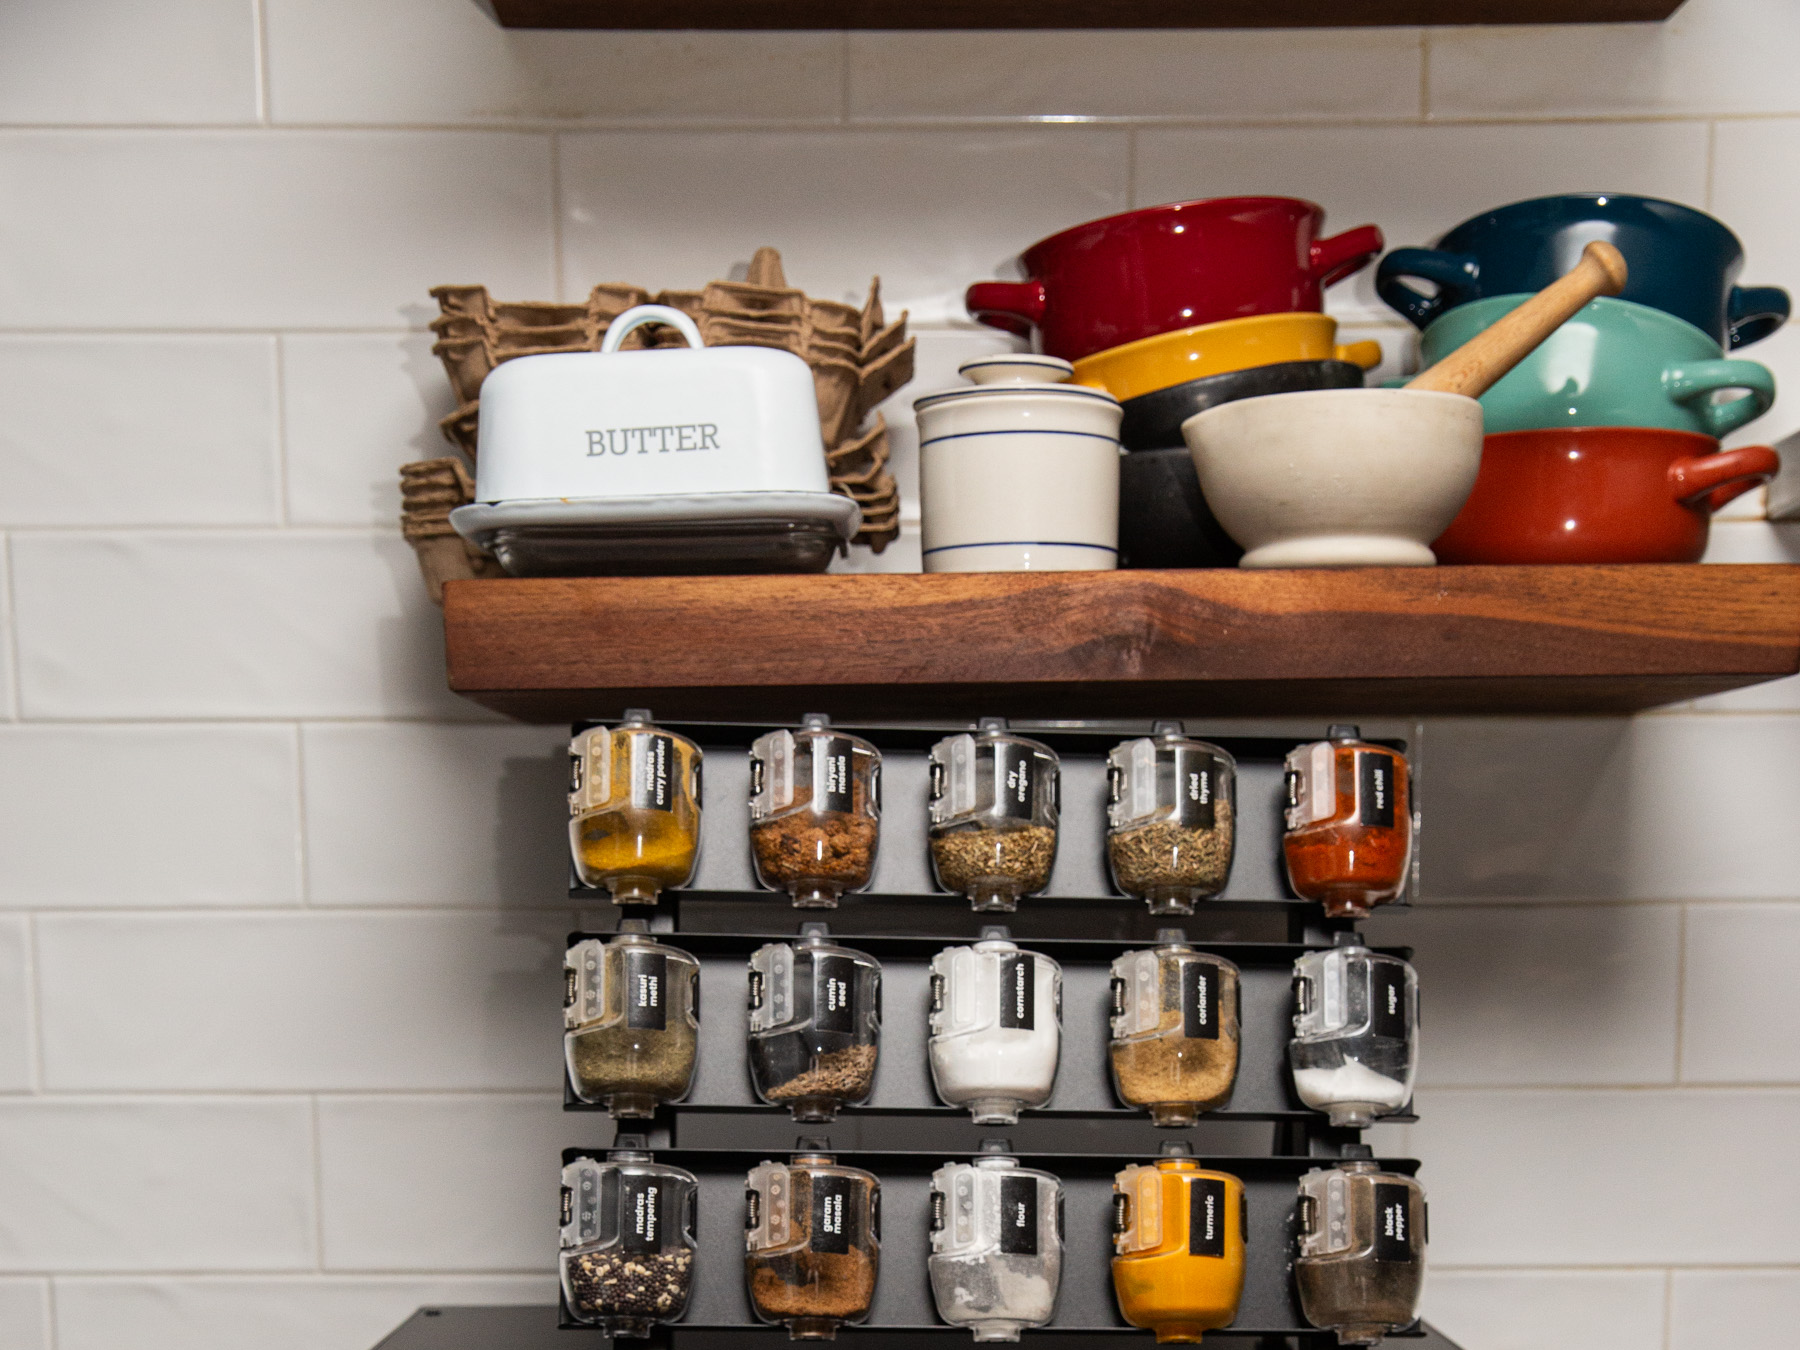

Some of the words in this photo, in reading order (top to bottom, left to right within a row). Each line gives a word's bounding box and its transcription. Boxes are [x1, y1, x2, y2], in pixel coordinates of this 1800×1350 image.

[585, 423, 720, 457] BUTTER
[645, 751, 655, 791] madras
[656, 739, 667, 778] powder
[826, 756, 838, 793] biryani
[837, 755, 846, 794] masala
[656, 777, 667, 805] curry
[1006, 770, 1018, 789] dry
[1018, 760, 1028, 802] oregano
[1189, 773, 1199, 800] dried
[1200, 771, 1210, 804] thyme
[1375, 791, 1384, 809] red
[637, 974, 647, 1007] kasuri
[648, 975, 658, 1007] methi
[826, 977, 837, 1011] cumin
[837, 981, 846, 1007] seed
[1015, 963, 1025, 1019] cornstarch
[1197, 975, 1207, 1025] coriander
[1388, 984, 1398, 1015] sugar
[634, 1193, 645, 1234] madras
[645, 1186, 658, 1241] tempering
[823, 1196, 834, 1232] garam
[833, 1194, 843, 1234] masala
[1016, 1202, 1026, 1227] flour
[1204, 1194, 1214, 1240] turmeric
[1384, 1206, 1394, 1236] black
[1395, 1203, 1405, 1241] pepper
